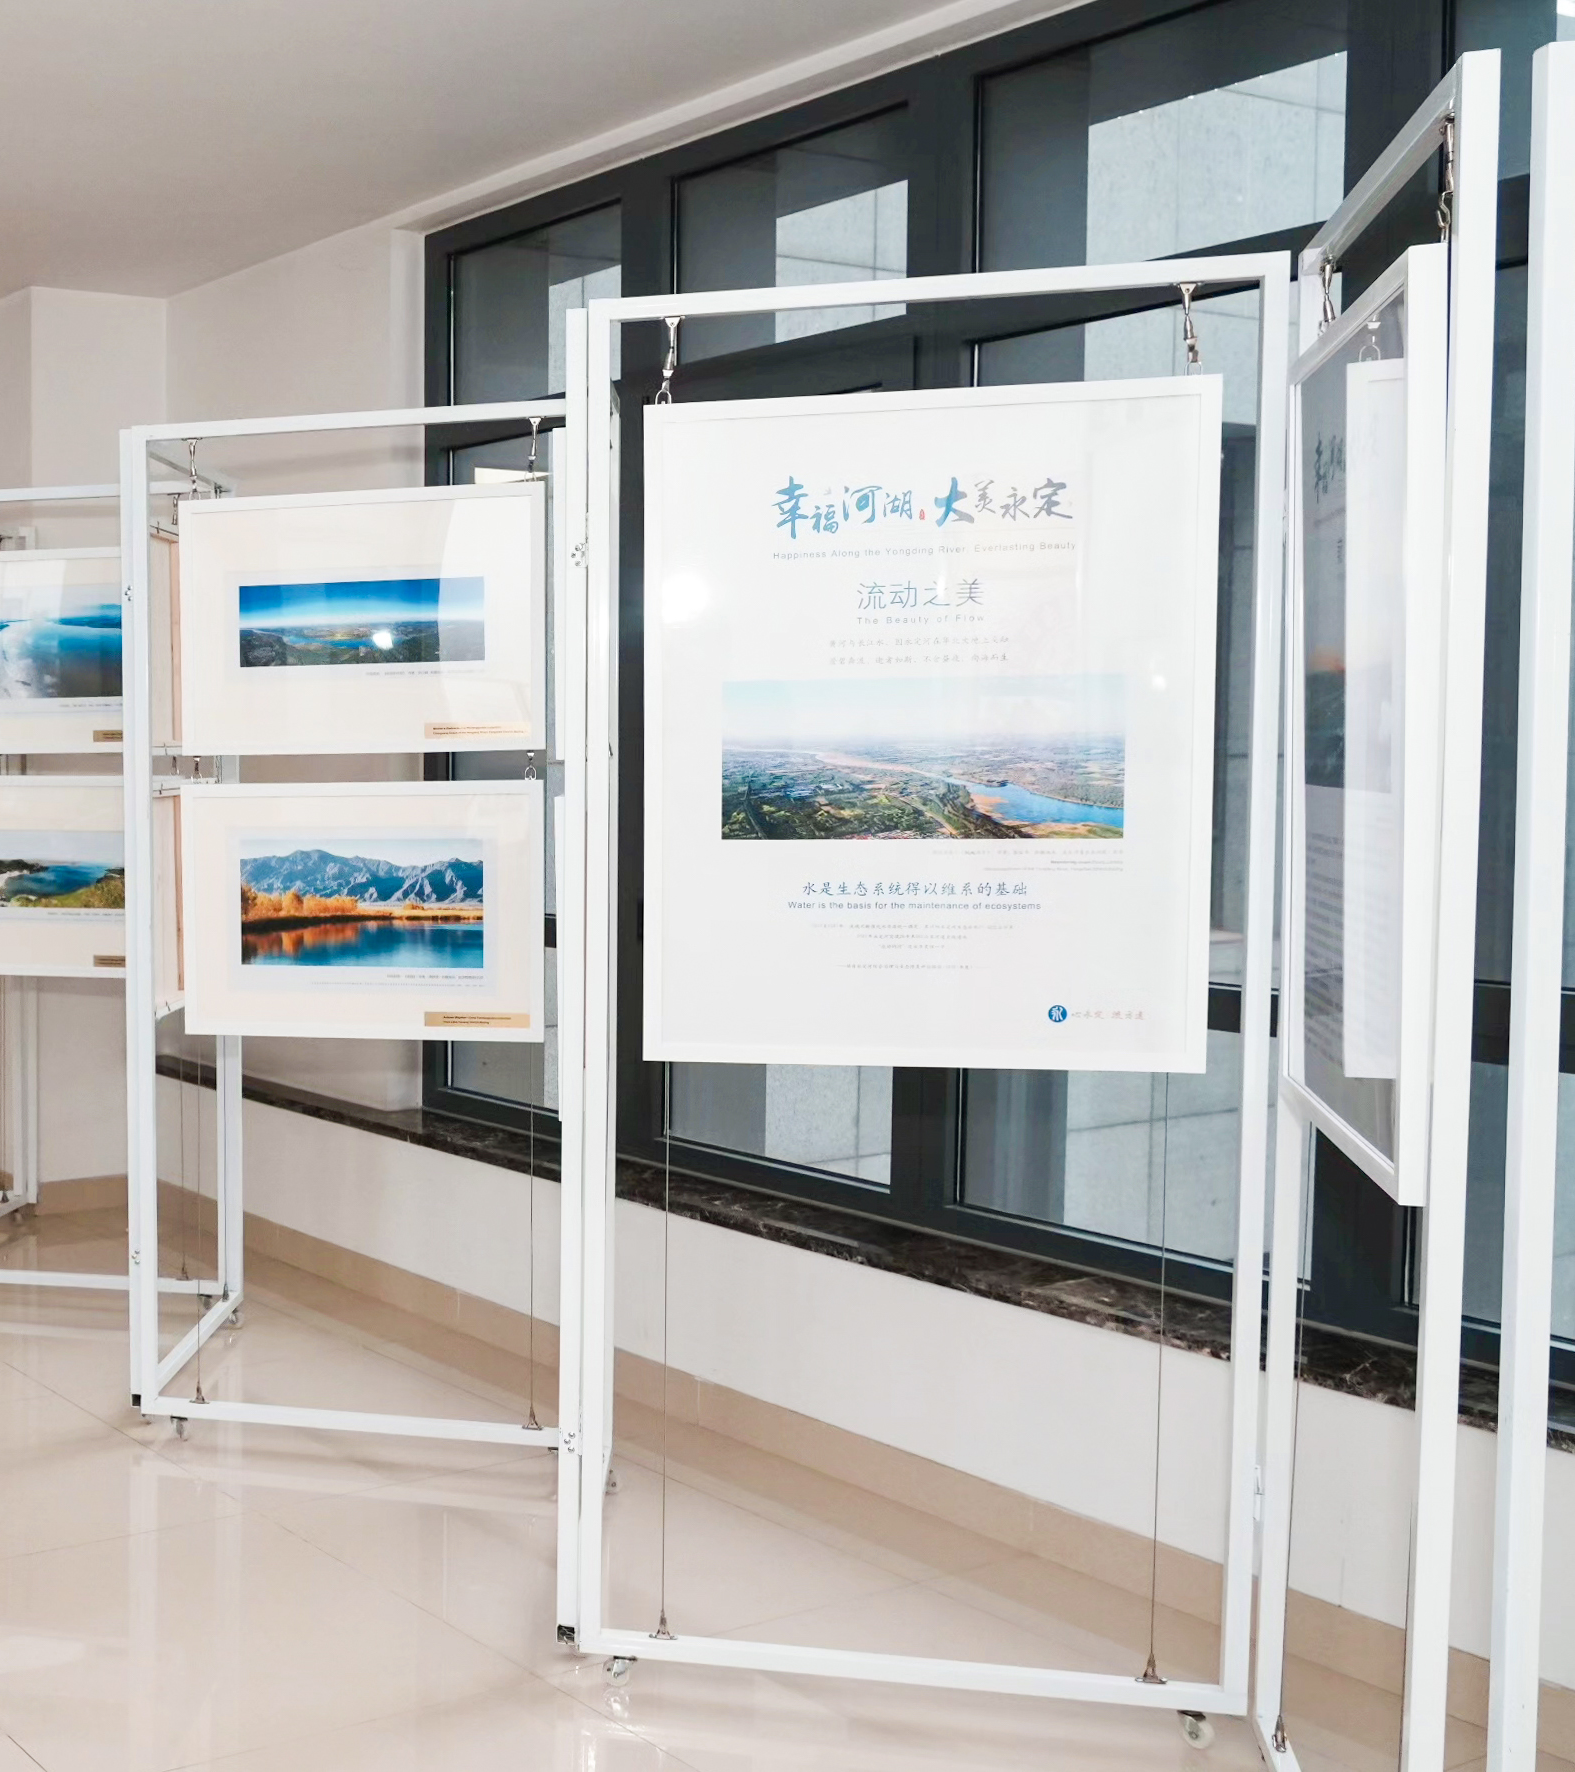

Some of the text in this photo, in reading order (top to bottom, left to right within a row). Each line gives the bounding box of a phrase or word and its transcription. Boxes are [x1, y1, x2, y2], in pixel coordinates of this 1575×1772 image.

[773, 550, 827, 560] Happiness
[830, 549, 861, 560] Along
[864, 548, 881, 557] the
[885, 546, 934, 557] Yongding
[974, 542, 1035, 554] Everlasting
[1039, 541, 1077, 552] Beauty
[856, 578, 985, 610] 流动之美
[857, 613, 986, 626] The Beauty of Flow
[802, 881, 1029, 897] 水是生态系统得以维系的基础
[788, 901, 1042, 912] Water is the basis for the maintenance of ecosystems
